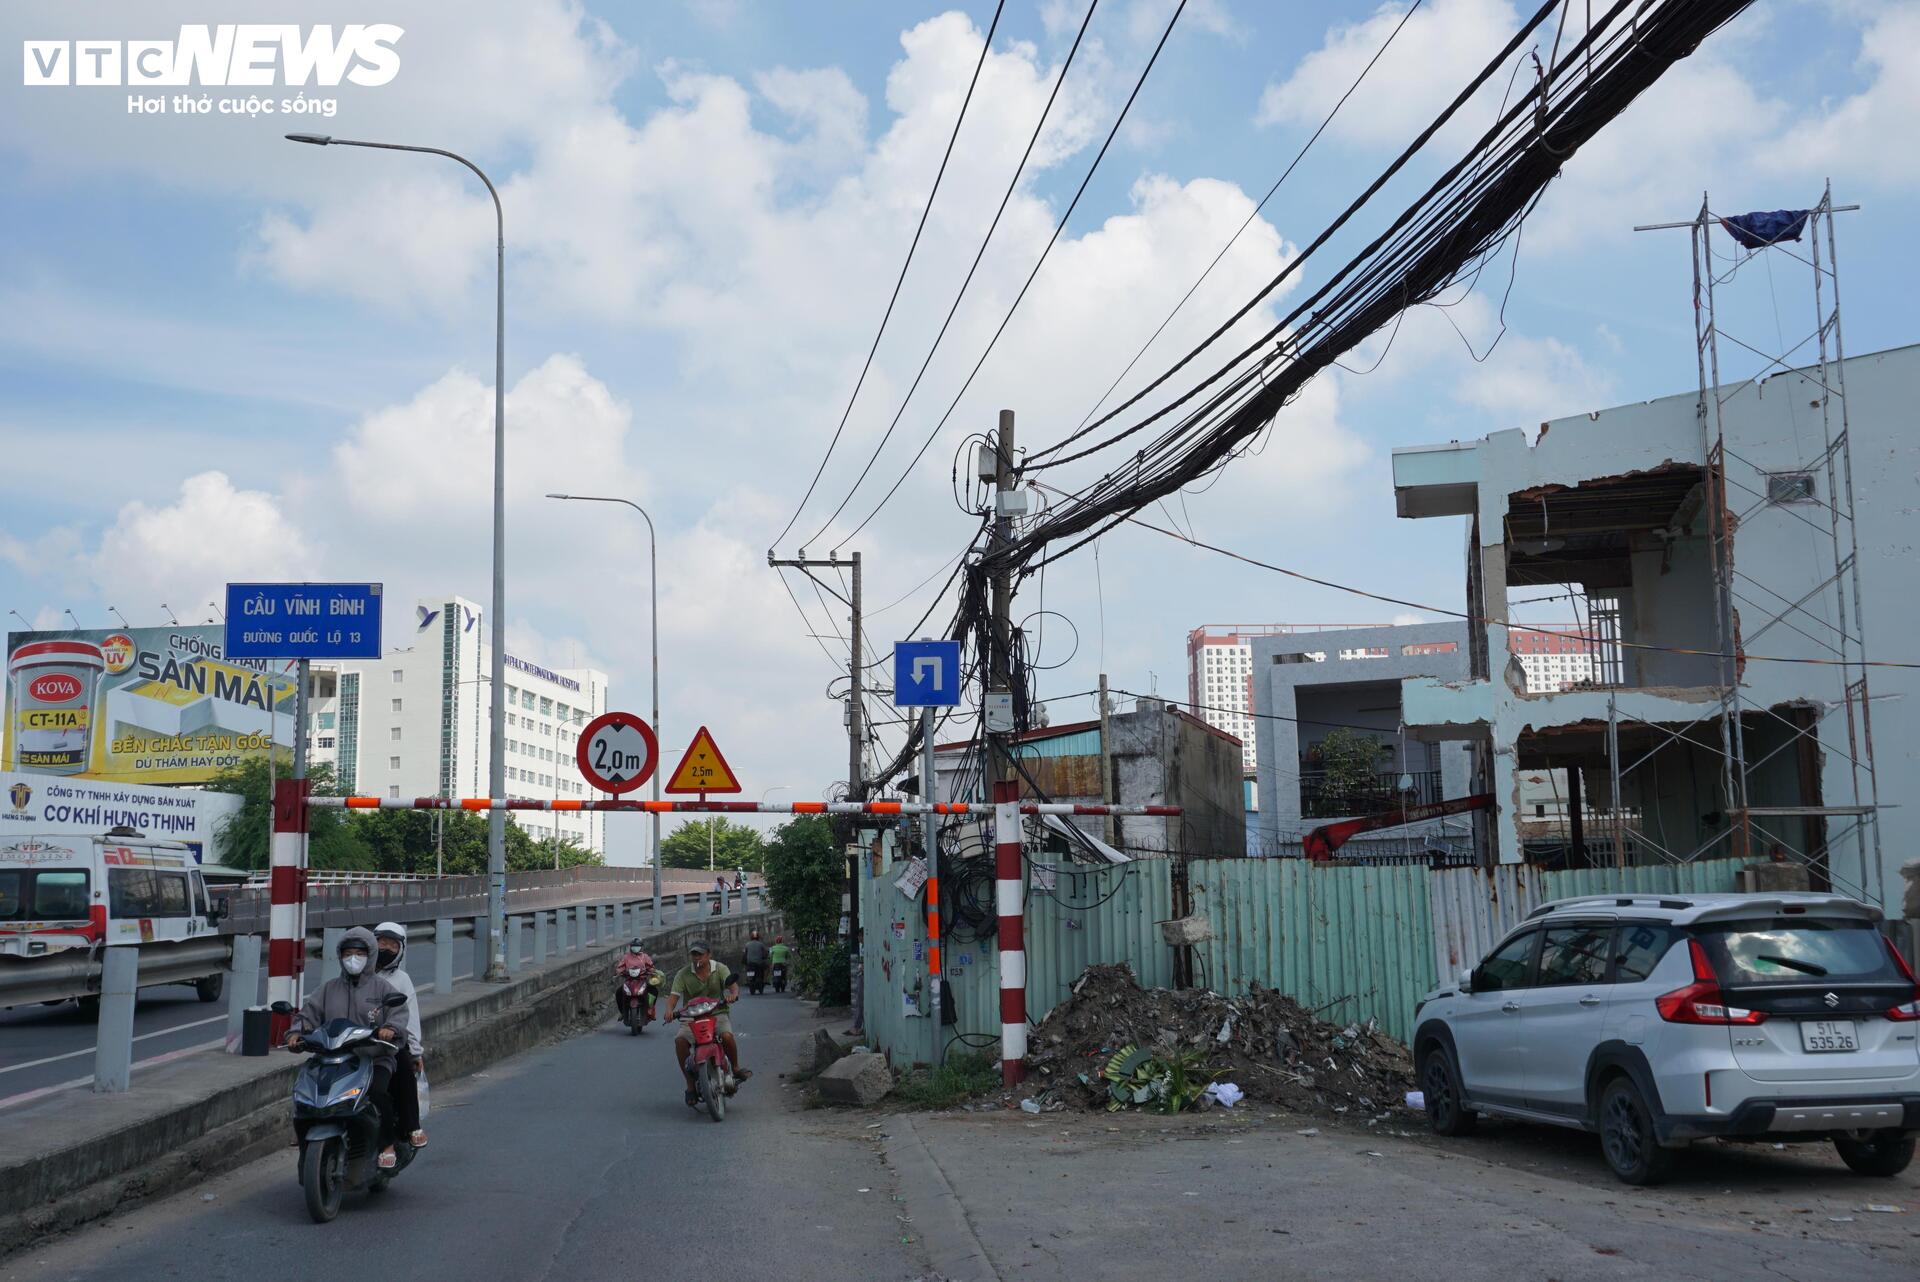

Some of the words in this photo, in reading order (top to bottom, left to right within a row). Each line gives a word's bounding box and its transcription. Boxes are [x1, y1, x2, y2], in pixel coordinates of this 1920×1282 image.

[244, 592, 274, 615] CẦU
[285, 594, 320, 615] VĨNH
[330, 593, 364, 615] BÌNH
[243, 628, 282, 643] ĐƯỜNG
[289, 627, 318, 643] QUỐC
[328, 630, 341, 645] LỘ
[350, 632, 361, 643] 13
[170, 634, 222, 660] CHỐNG
[106, 653, 125, 664] UV
[37, 682, 75, 695] KOVA
[138, 650, 206, 695] SÀN
[214, 670, 273, 712] MÁI
[29, 713, 77, 726] CT-11A
[150, 732, 193, 752] CHẮC
[197, 732, 231, 753] TẬN
[235, 729, 272, 749] GỐC
[191, 757, 213, 767] HAY
[47, 785, 73, 798] CÔNG
[75, 790, 86, 799] TY
[88, 791, 111, 801] TNHH
[113, 792, 130, 803] XÂY
[132, 795, 155, 806] DỰNG
[44, 804, 71, 822] CƠ
[73, 805, 102, 825] KHÍ
[104, 809, 149, 828] HƯNG
[152, 813, 195, 834] THỊNH
[1816, 1022, 1842, 1035] 51L
[1810, 1036, 1854, 1049] 535.26
